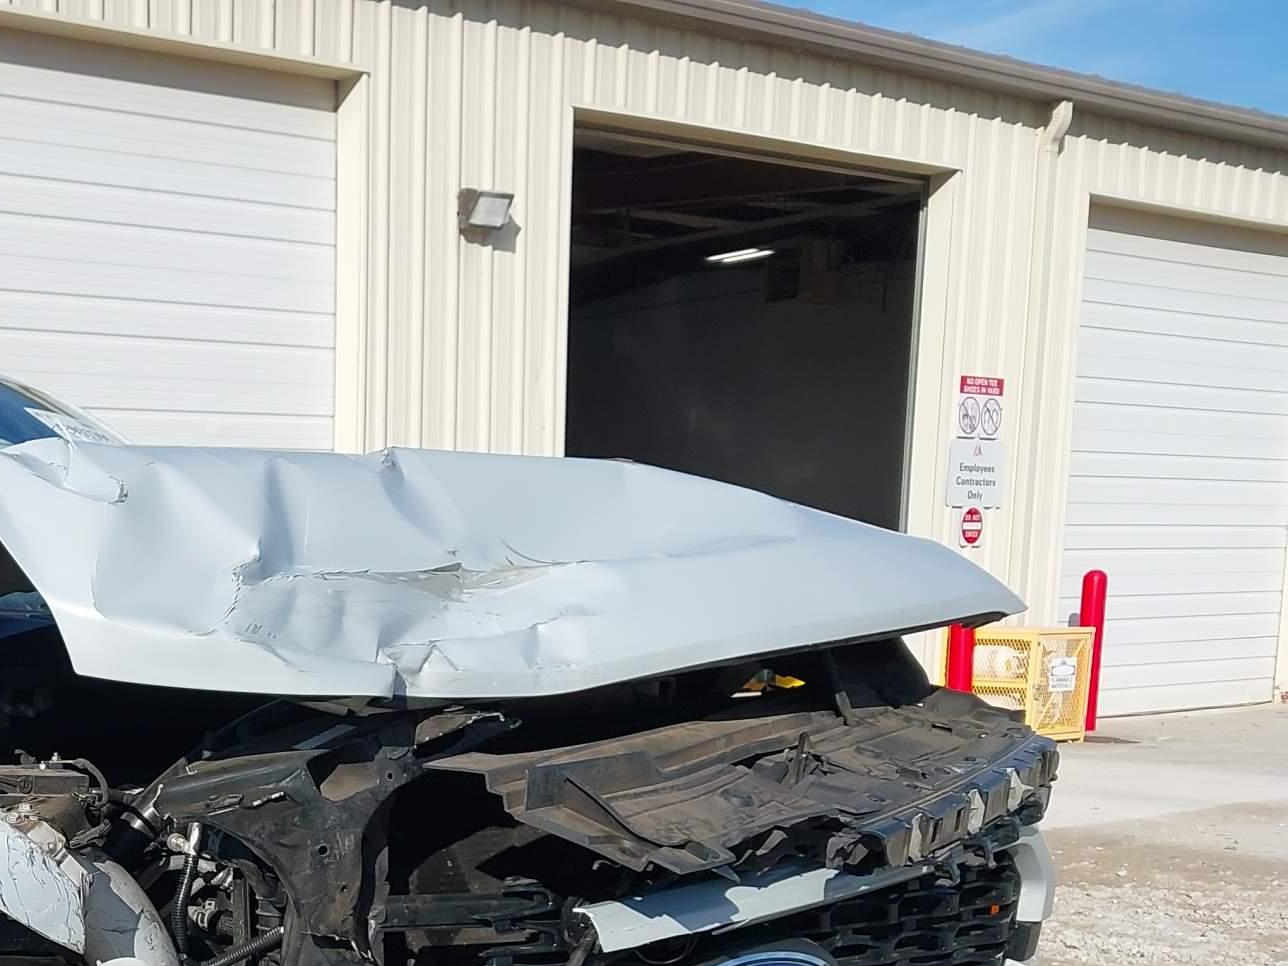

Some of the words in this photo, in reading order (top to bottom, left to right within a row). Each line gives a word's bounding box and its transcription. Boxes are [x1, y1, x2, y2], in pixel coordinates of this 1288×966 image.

[959, 462, 995, 474] Employees
[956, 476, 996, 487] Contractors
[967, 490, 983, 501] Only
